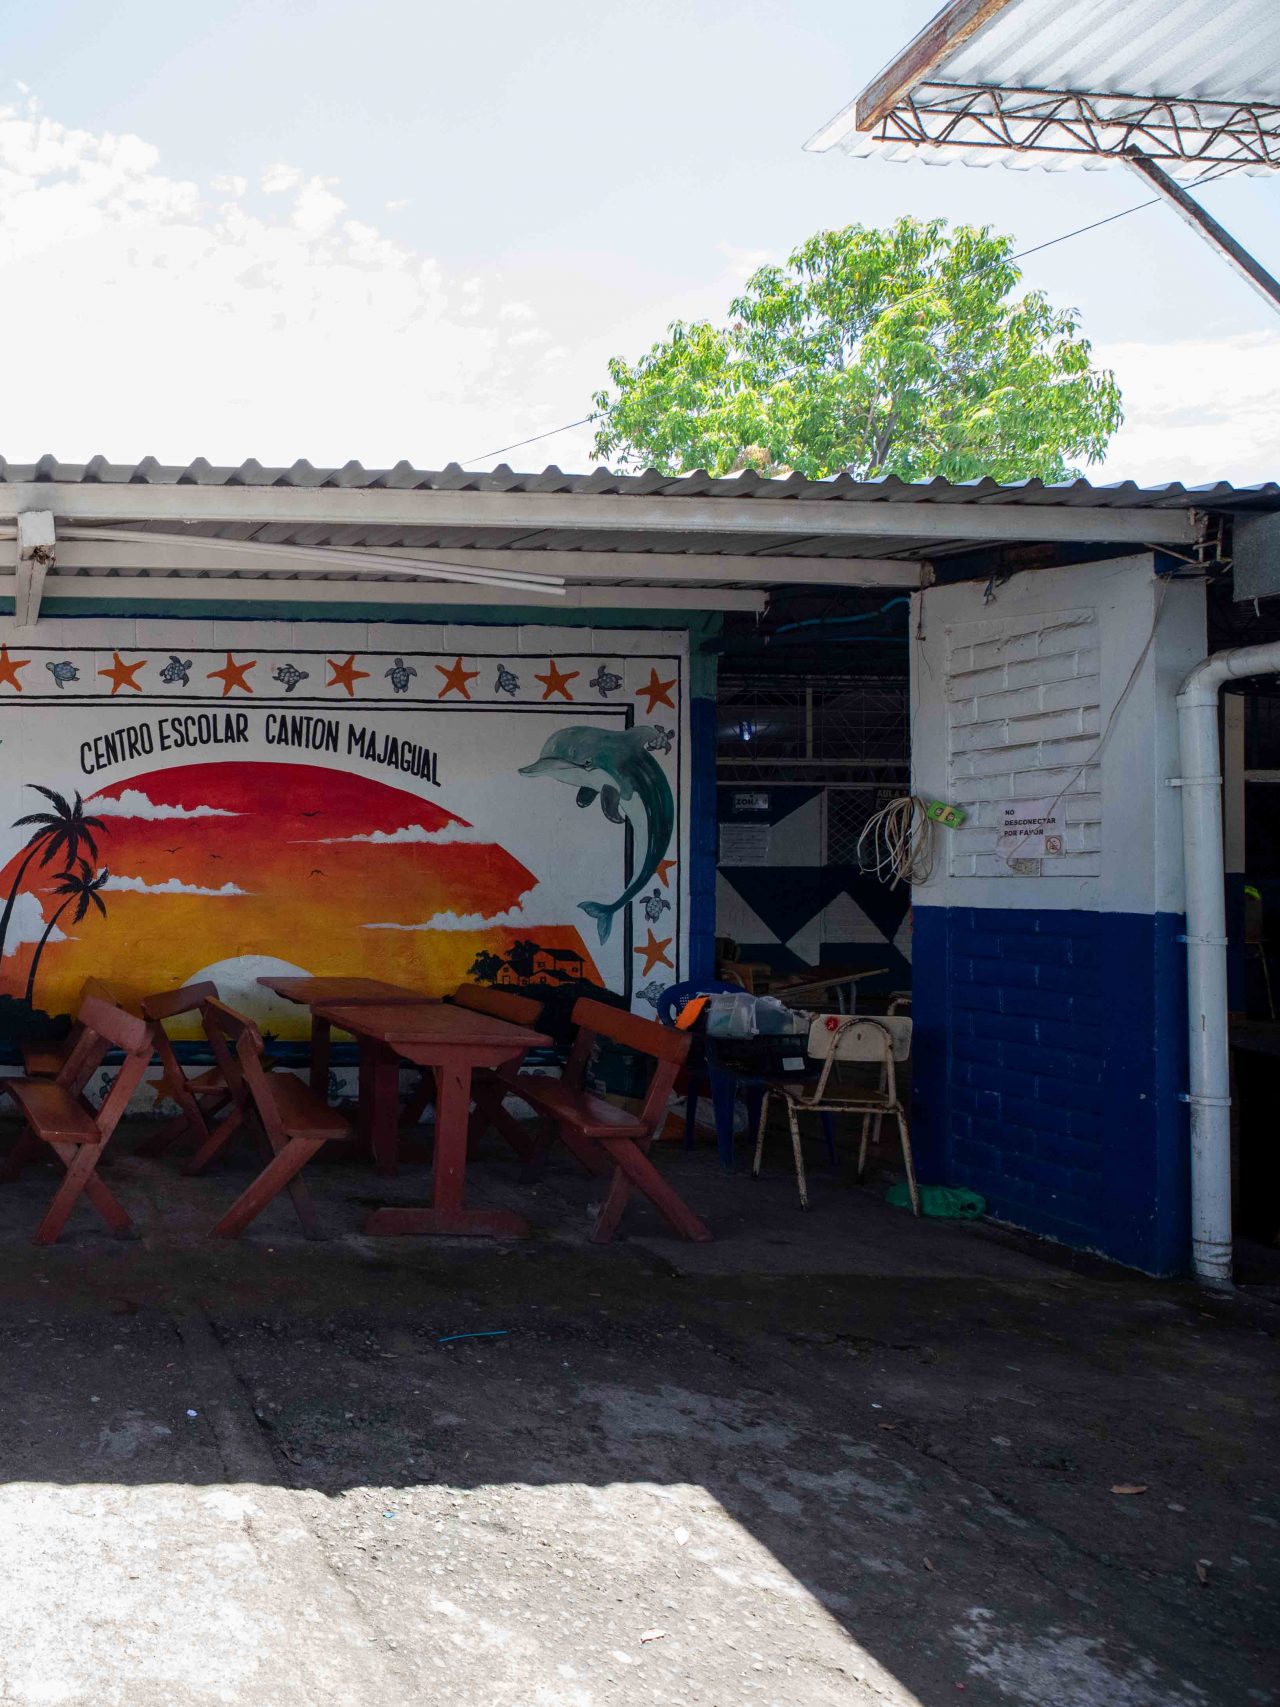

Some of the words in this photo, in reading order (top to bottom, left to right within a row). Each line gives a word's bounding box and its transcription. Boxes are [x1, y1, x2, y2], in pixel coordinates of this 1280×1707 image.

[80, 721, 154, 775] CENTRO
[158, 713, 249, 752] ESCOLAR
[265, 713, 340, 753] CANTON
[346, 723, 442, 787] MAJAGUAL
